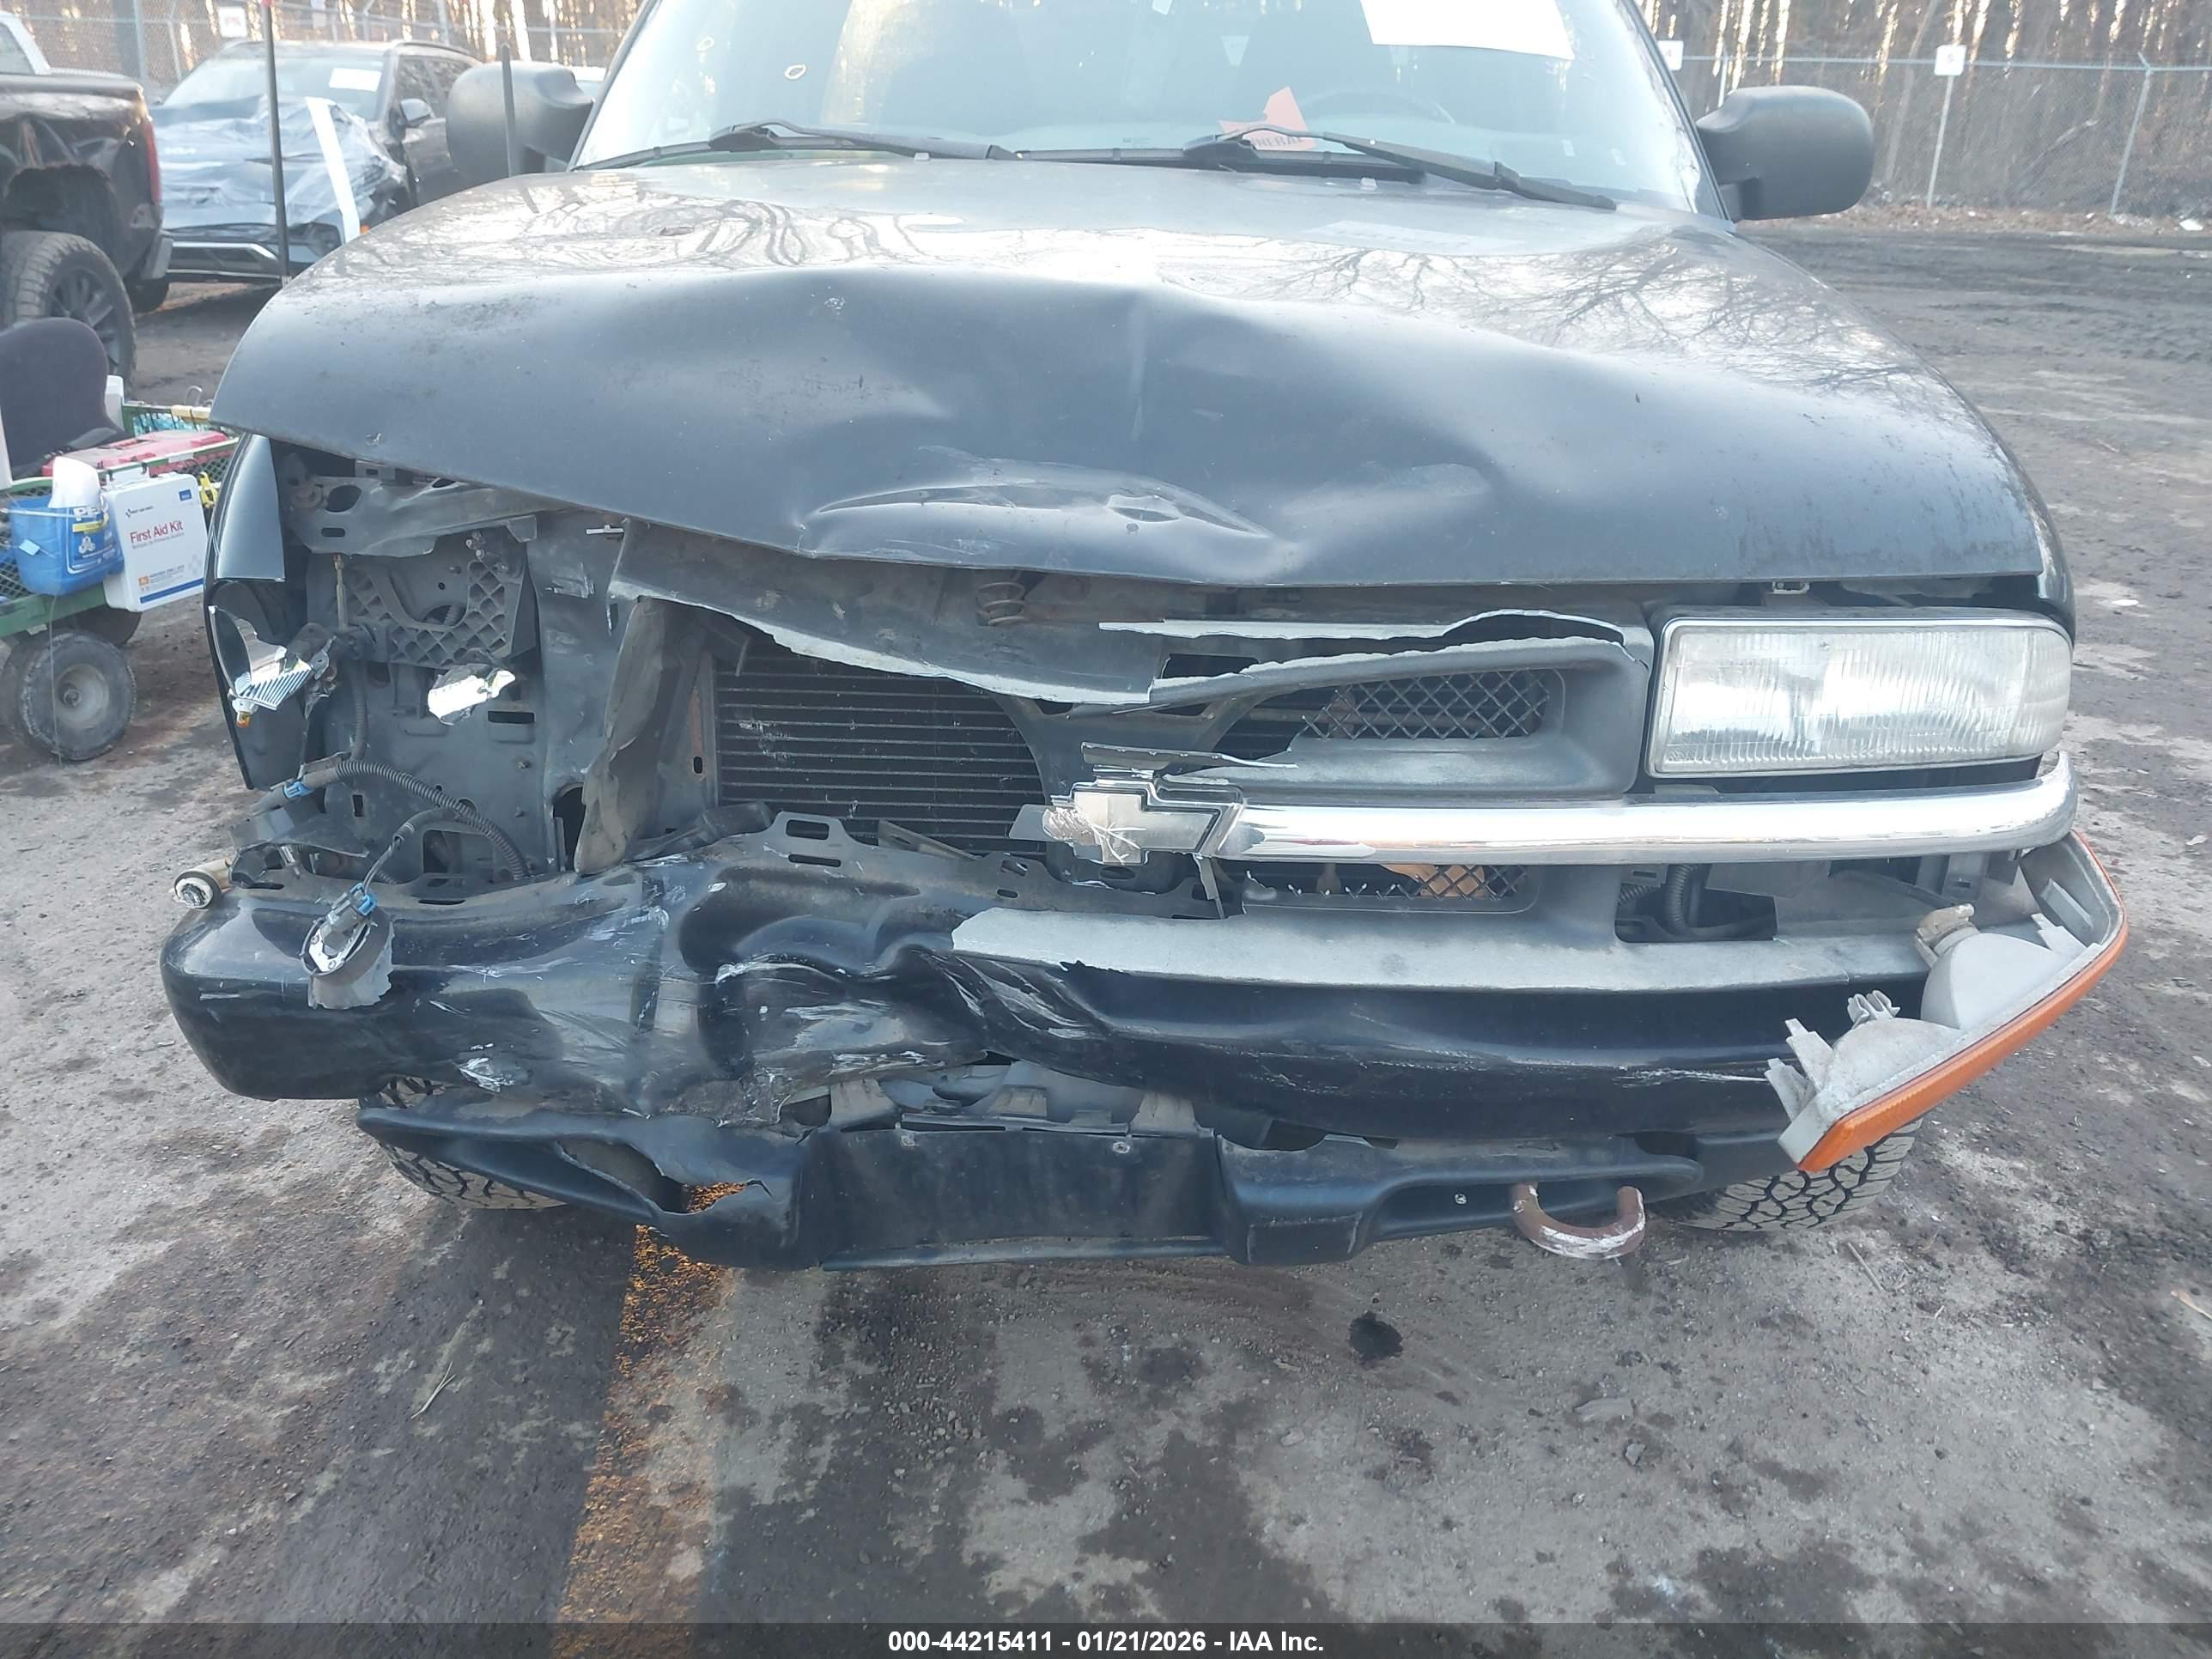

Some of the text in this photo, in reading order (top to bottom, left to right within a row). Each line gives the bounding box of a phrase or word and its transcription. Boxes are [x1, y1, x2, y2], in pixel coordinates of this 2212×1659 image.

[130, 529, 152, 544] First
[153, 523, 168, 538] Aid
[169, 520, 184, 533] Kit
